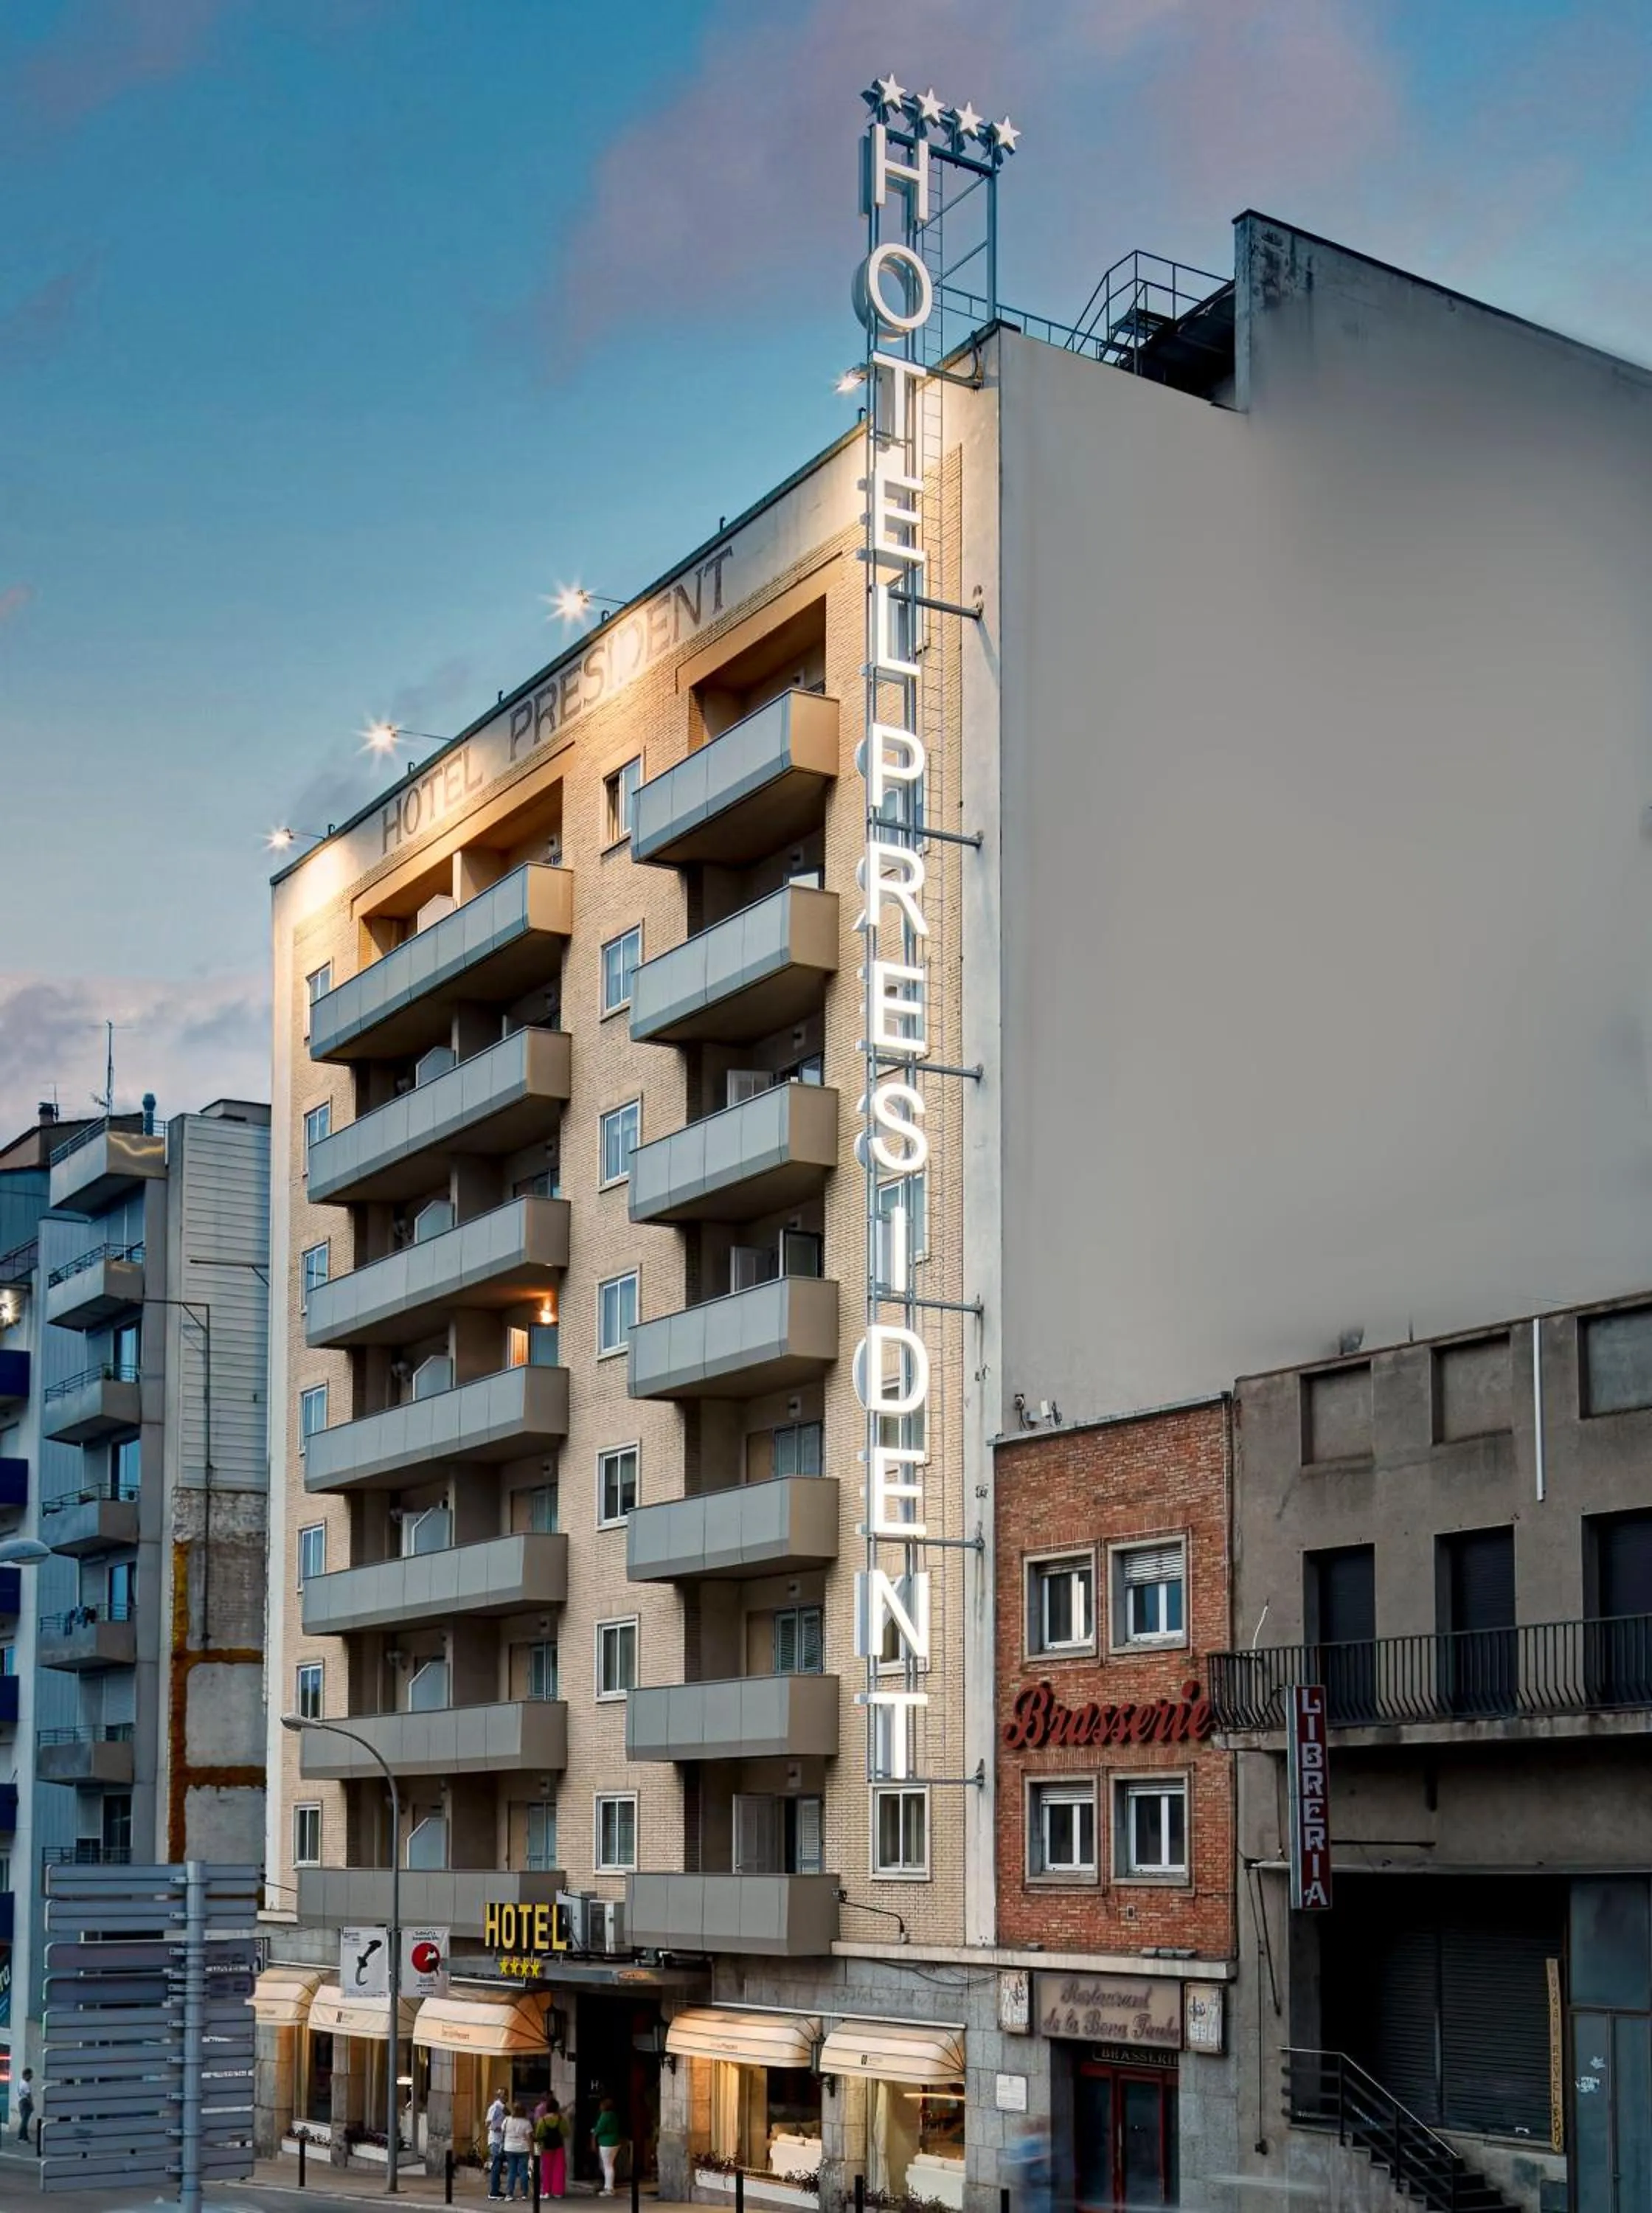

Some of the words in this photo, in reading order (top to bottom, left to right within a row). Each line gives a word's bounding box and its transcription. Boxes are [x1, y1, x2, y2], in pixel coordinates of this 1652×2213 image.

[864, 122, 933, 677] HOTEL
[382, 745, 483, 856] HOTEL
[508, 545, 734, 762] PRESIDENT
[866, 722, 931, 1779] PRESIDENT
[1002, 1679, 1217, 1749] Brasserie
[1301, 1688, 1328, 1907] LIBRERIA
[484, 1902, 568, 1951] HOTEL
[1060, 1978, 1153, 2008] Restaurant
